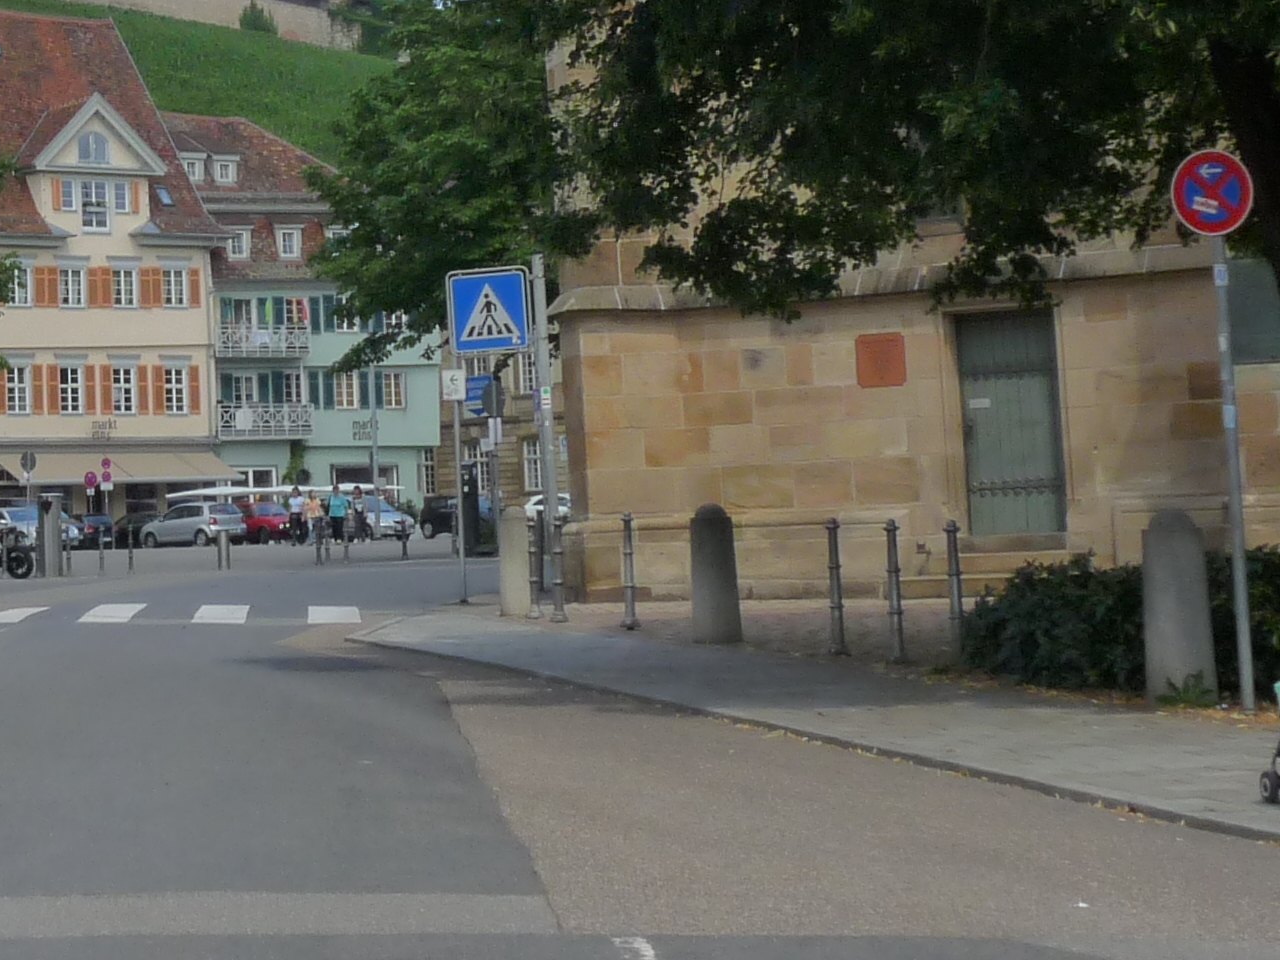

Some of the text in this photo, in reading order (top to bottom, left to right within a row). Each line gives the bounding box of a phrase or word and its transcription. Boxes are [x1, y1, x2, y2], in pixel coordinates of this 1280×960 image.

[91, 417, 118, 430] markt
[92, 429, 111, 441] eins
[352, 429, 372, 441] eins
